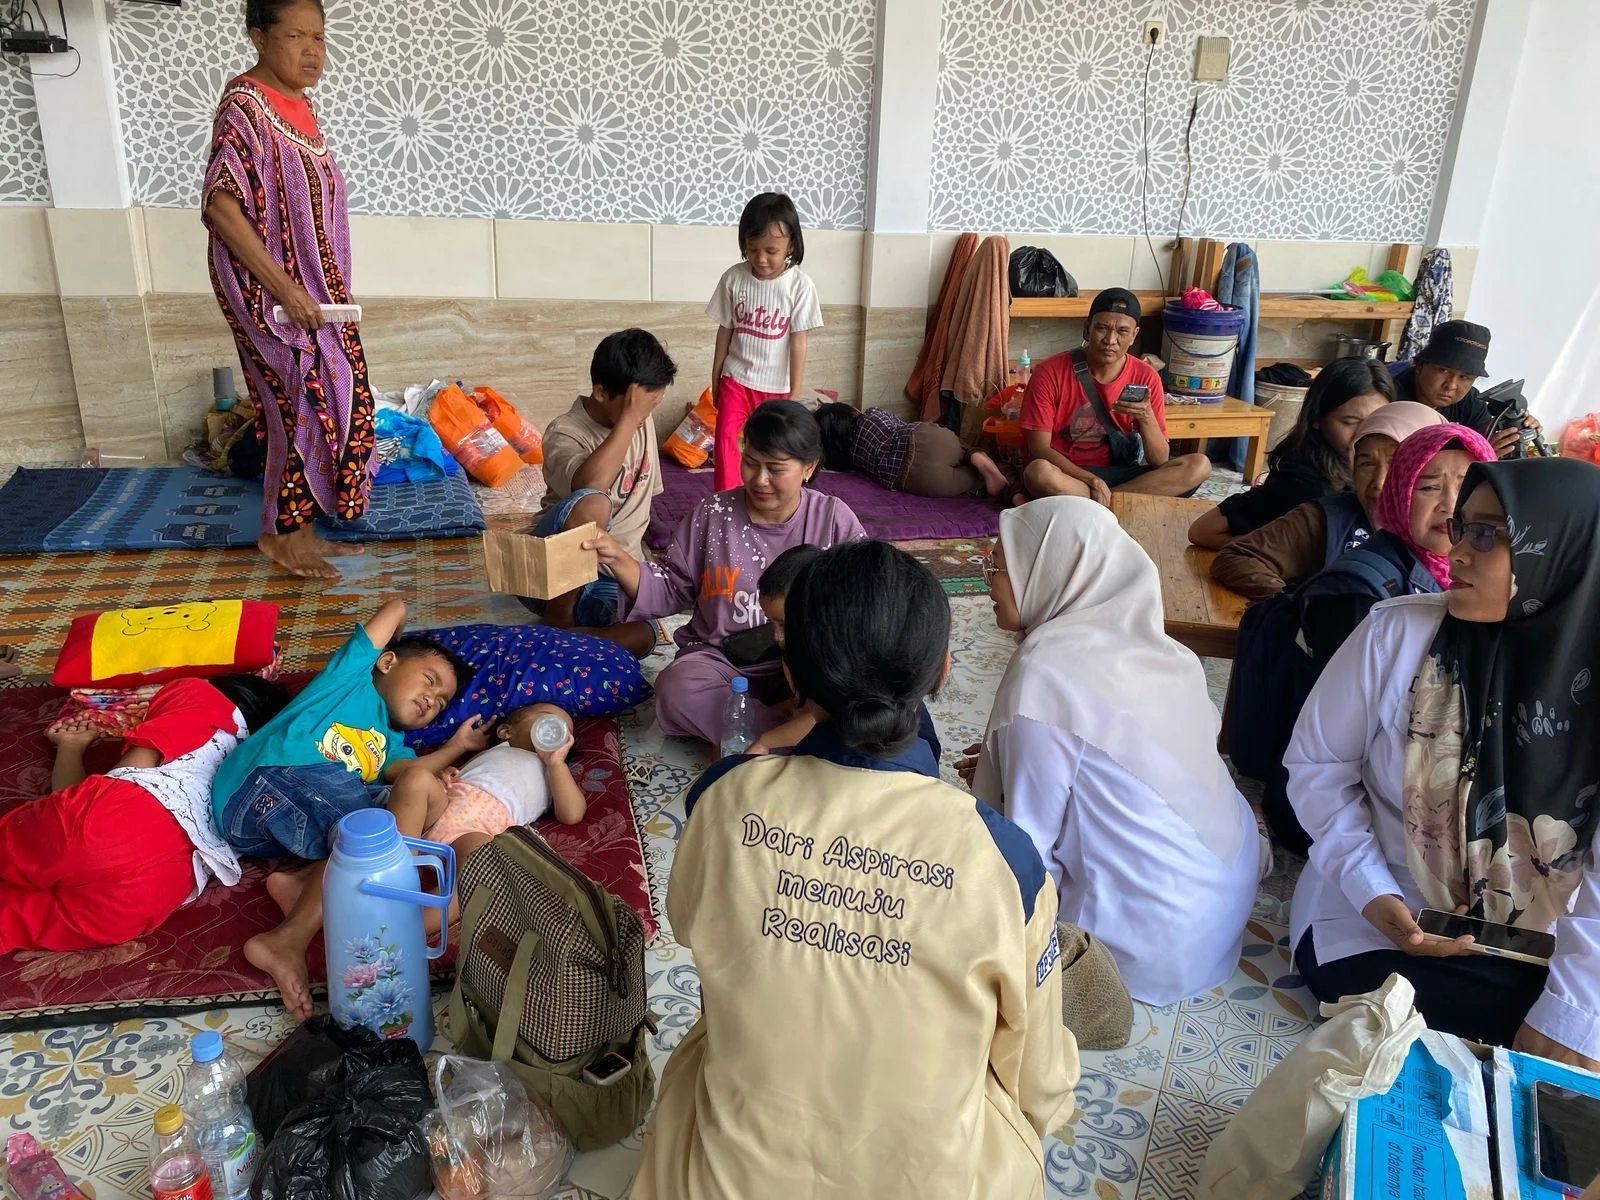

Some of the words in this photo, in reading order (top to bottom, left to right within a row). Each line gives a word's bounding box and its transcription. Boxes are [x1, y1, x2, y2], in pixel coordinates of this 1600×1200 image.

[734, 302, 791, 339] Cutely
[733, 590, 768, 629] SH
[742, 813, 813, 860] Dari
[822, 836, 956, 890] Aspirasi
[777, 869, 905, 920] menuju
[762, 907, 912, 967] Realisasi
[1387, 1141, 1404, 1154] di
[1411, 1141, 1428, 1184] Temukan
[1384, 1152, 1404, 1198] dalamnya
